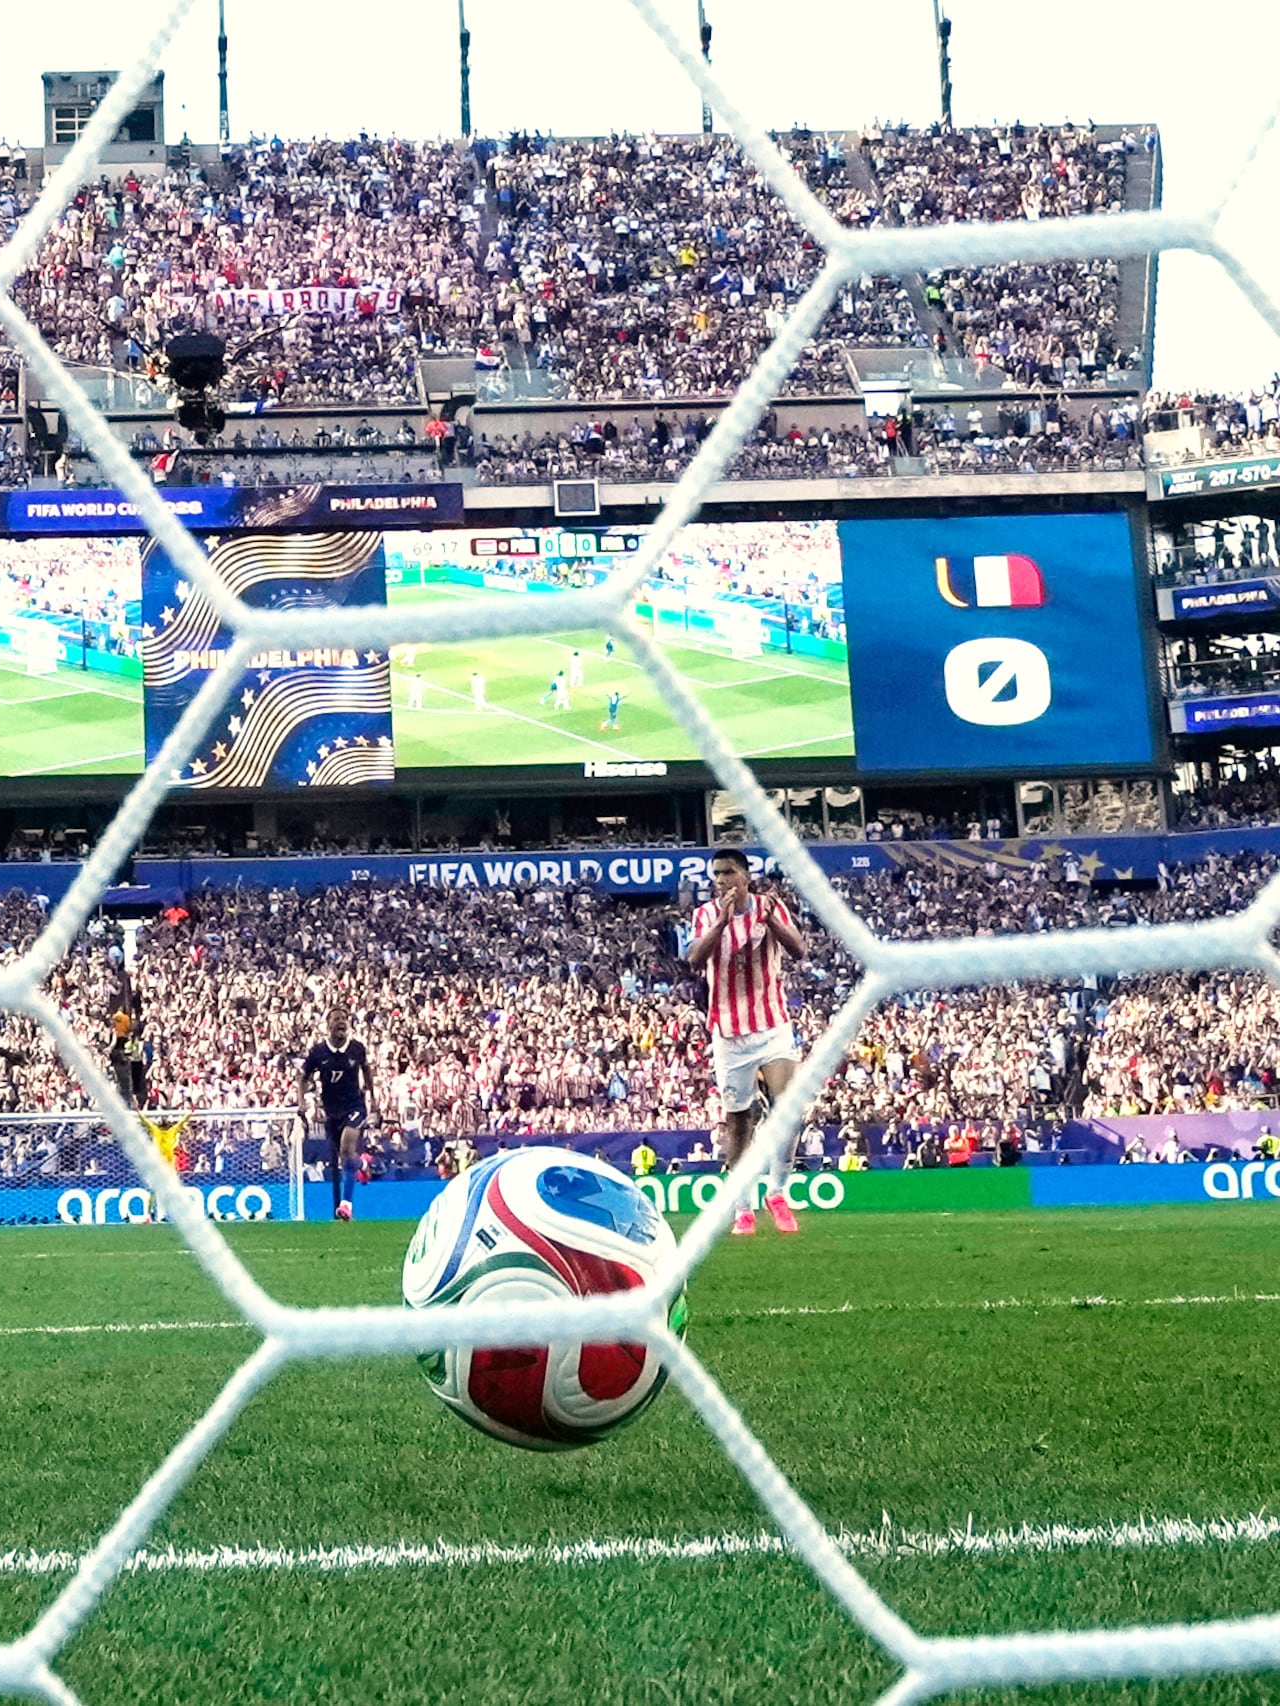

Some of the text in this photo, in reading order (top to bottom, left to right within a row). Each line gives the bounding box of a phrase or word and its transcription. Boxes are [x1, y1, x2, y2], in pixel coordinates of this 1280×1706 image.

[27, 503, 61, 517] FIFA
[62, 503, 116, 516] WORLD
[117, 502, 143, 516] CU
[330, 497, 437, 511] PHILADELPHIA
[1182, 590, 1268, 609] PHILADELPHIA
[944, 637, 1051, 726] 0
[410, 862, 480, 889] FIFA
[483, 858, 603, 888] WORLD
[608, 857, 673, 885] CUP
[331, 1070, 344, 1083] 17
